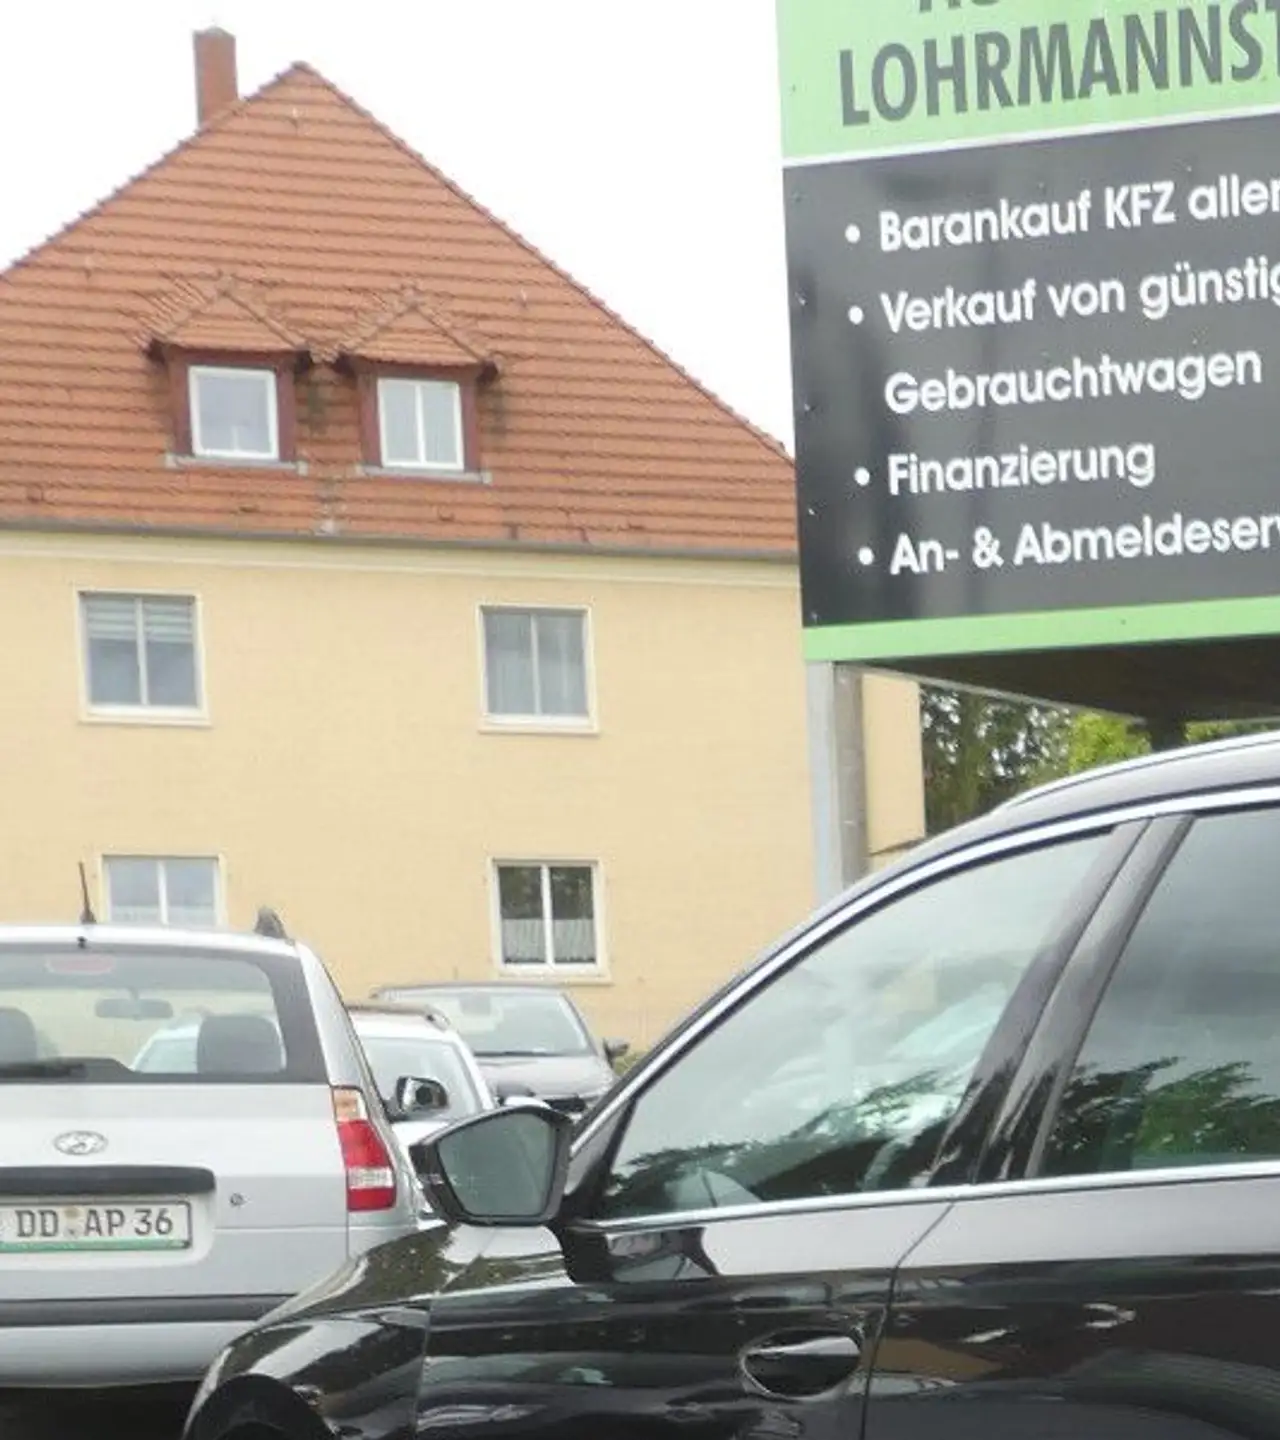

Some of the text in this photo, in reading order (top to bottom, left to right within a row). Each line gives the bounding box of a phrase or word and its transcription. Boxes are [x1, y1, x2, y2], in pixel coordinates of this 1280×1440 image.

[879, 189, 1092, 252] Barankauf
[1104, 181, 1177, 229] KFZ
[880, 278, 1036, 333] Verkauf
[1047, 280, 1126, 320] von
[884, 350, 1263, 414] Gebrauchtwagen
[888, 443, 1156, 495] Finanzierung
[890, 533, 960, 575] An-
[971, 527, 1005, 568] &
[15, 1207, 173, 1238] DD AP 36
